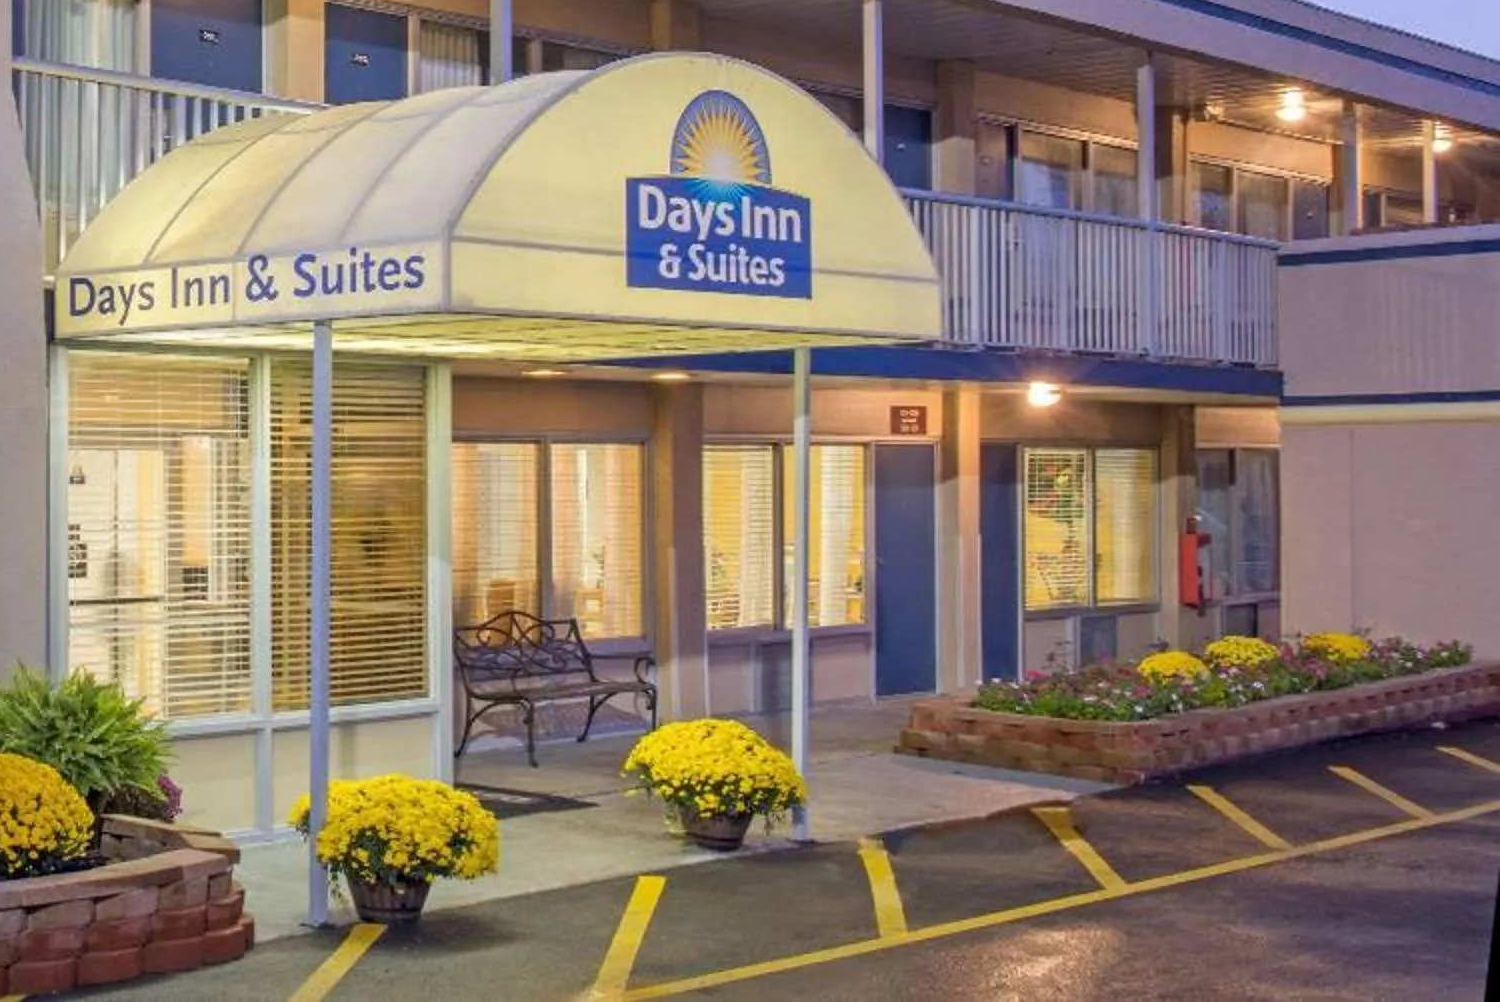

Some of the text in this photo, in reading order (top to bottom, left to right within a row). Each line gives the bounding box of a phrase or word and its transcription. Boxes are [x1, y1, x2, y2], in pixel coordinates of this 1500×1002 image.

[638, 183, 802, 243] Days Inn
[68, 247, 425, 326] Days Inn & Suites
[658, 243, 786, 287] & Suites
